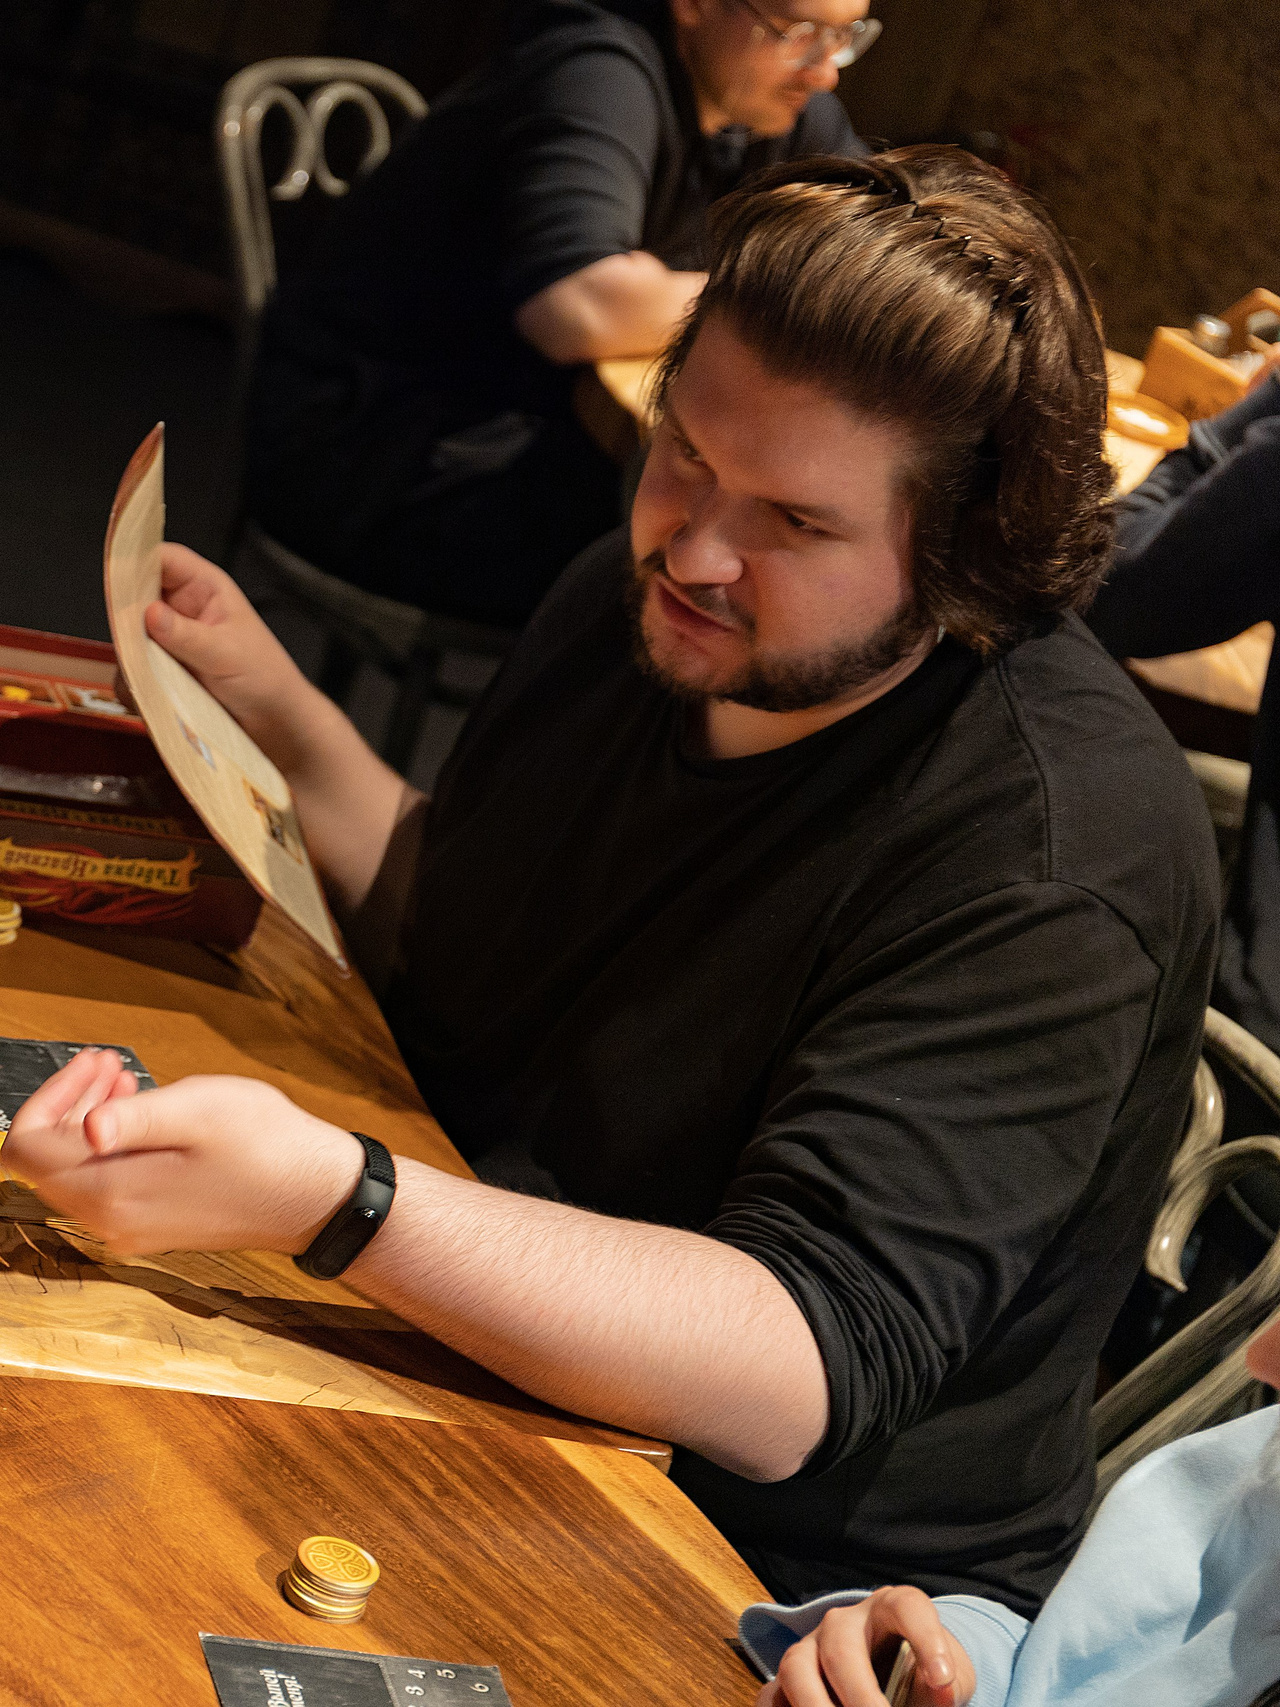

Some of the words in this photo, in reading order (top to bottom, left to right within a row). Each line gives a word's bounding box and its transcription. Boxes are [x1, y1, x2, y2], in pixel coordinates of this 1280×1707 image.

[102, 863, 182, 888] Таверна
[408, 1669, 426, 1678] 4
[436, 1669, 456, 1679] 5
[405, 1685, 425, 1696] 3
[470, 1683, 489, 1693] 6
